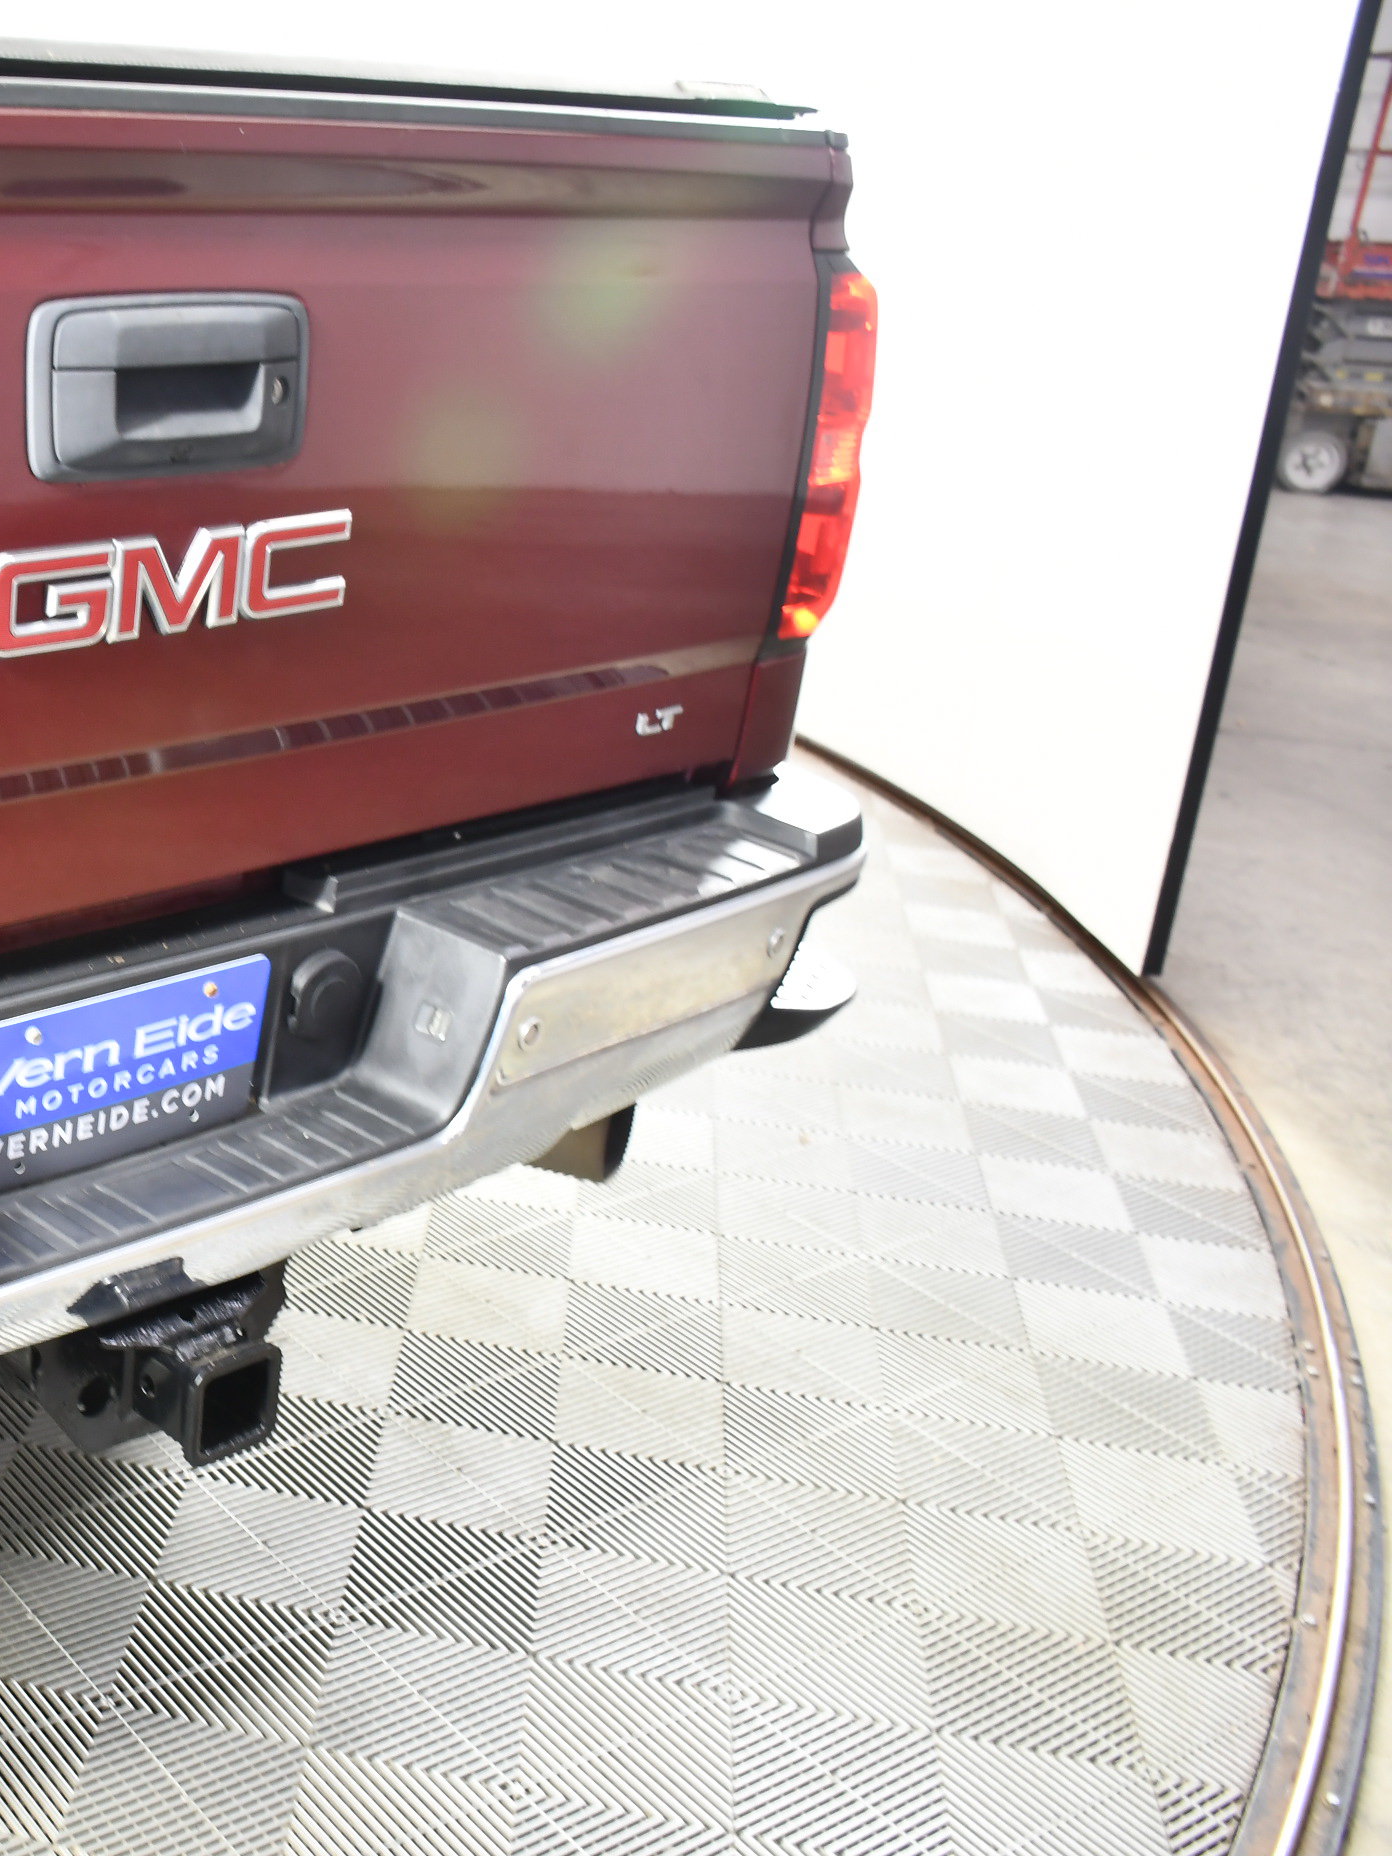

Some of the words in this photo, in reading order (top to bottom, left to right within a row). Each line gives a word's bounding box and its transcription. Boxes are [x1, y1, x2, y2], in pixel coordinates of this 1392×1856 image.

[635, 704, 684, 736] LT
[133, 1001, 257, 1059] Eide
[14, 1045, 220, 1119] MOTORCARS
